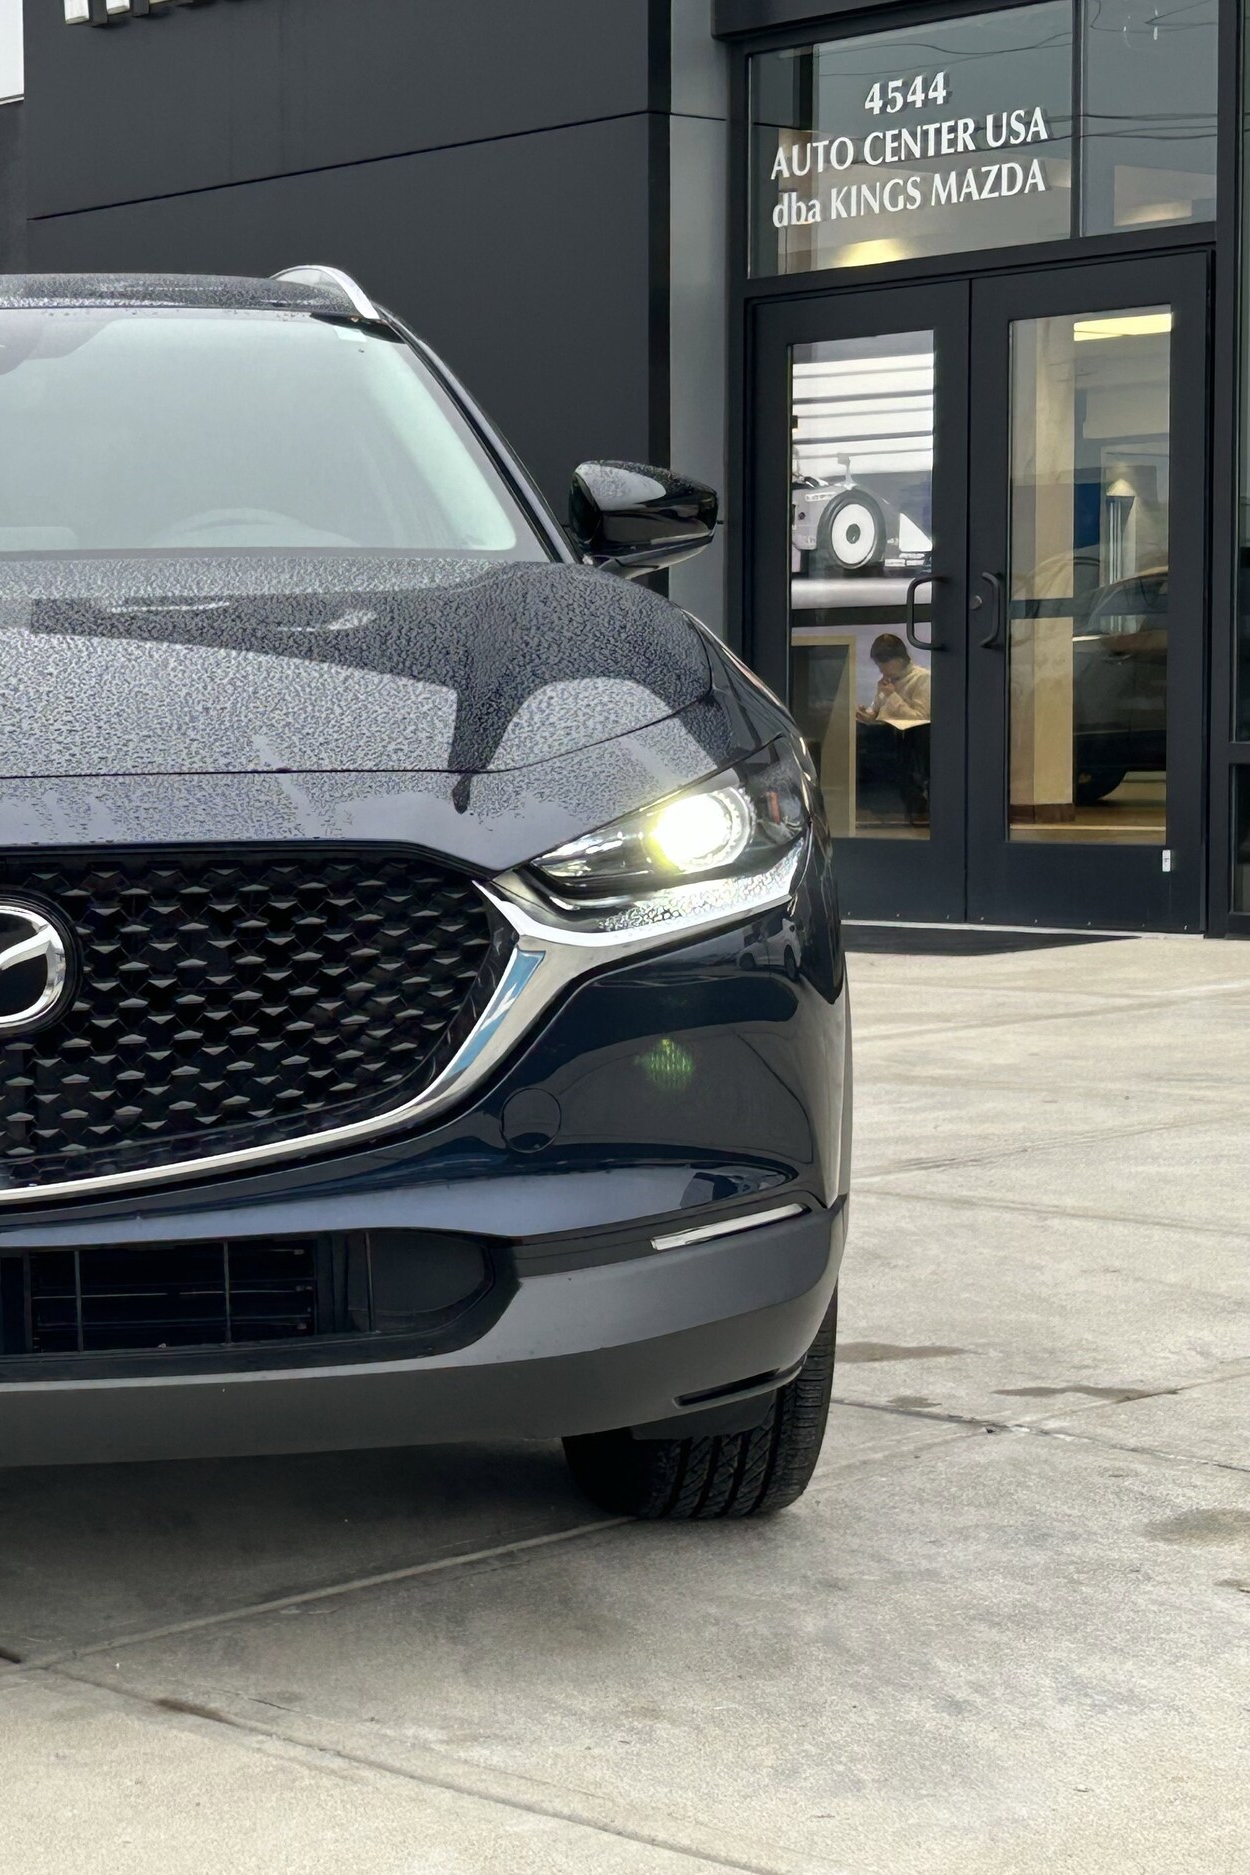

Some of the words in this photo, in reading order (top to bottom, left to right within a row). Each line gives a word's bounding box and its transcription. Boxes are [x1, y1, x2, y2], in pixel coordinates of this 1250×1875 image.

[865, 72, 947, 115] 4544
[771, 137, 854, 180] AUTO
[864, 118, 976, 166] CENTER
[986, 107, 1048, 147] USA
[773, 192, 822, 227] dba
[831, 176, 921, 219] KINGS
[931, 159, 1046, 206] MAZDA
